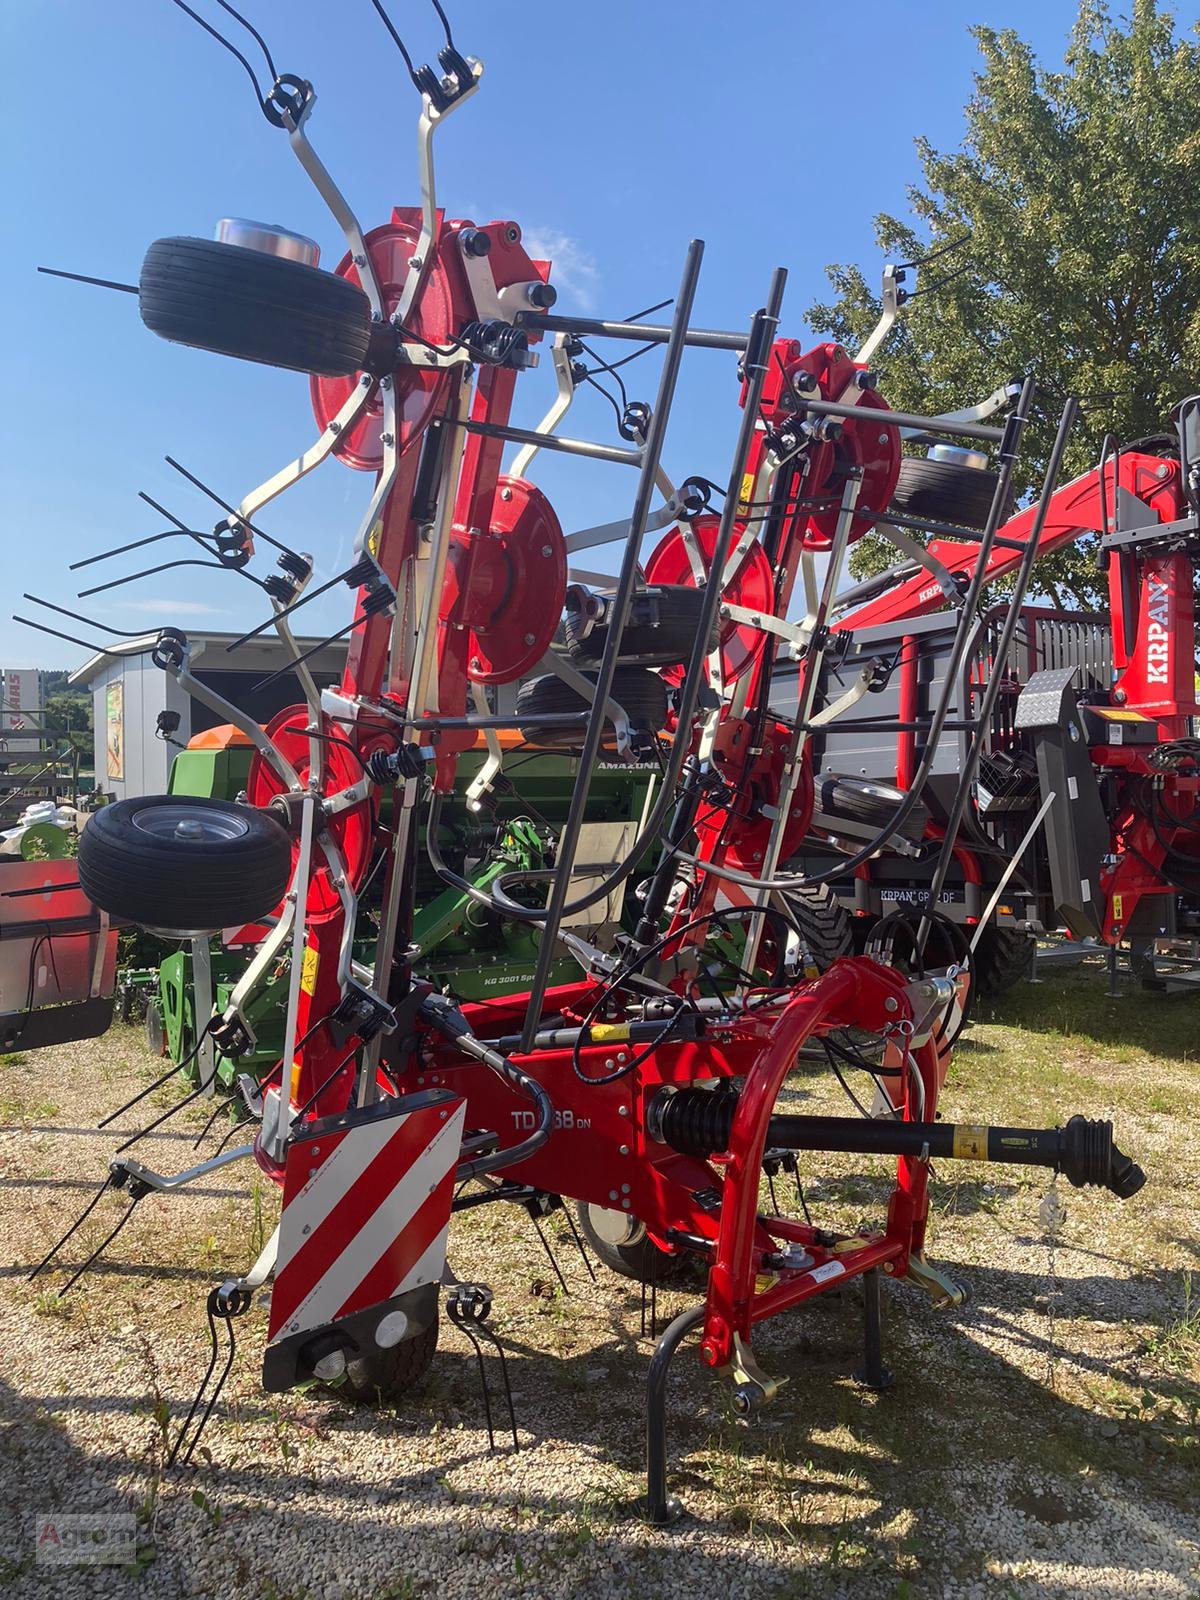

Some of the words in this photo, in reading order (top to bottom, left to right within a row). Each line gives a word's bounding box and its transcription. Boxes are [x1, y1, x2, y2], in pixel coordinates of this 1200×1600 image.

[1147, 581, 1169, 684] KRPAN
[598, 762, 661, 770] AMAZONE
[880, 890, 913, 901] KRPAN
[943, 892, 955, 904] DF
[498, 975, 520, 984] 3001
[511, 1111, 536, 1130] TD
[576, 1118, 591, 1129] DN
